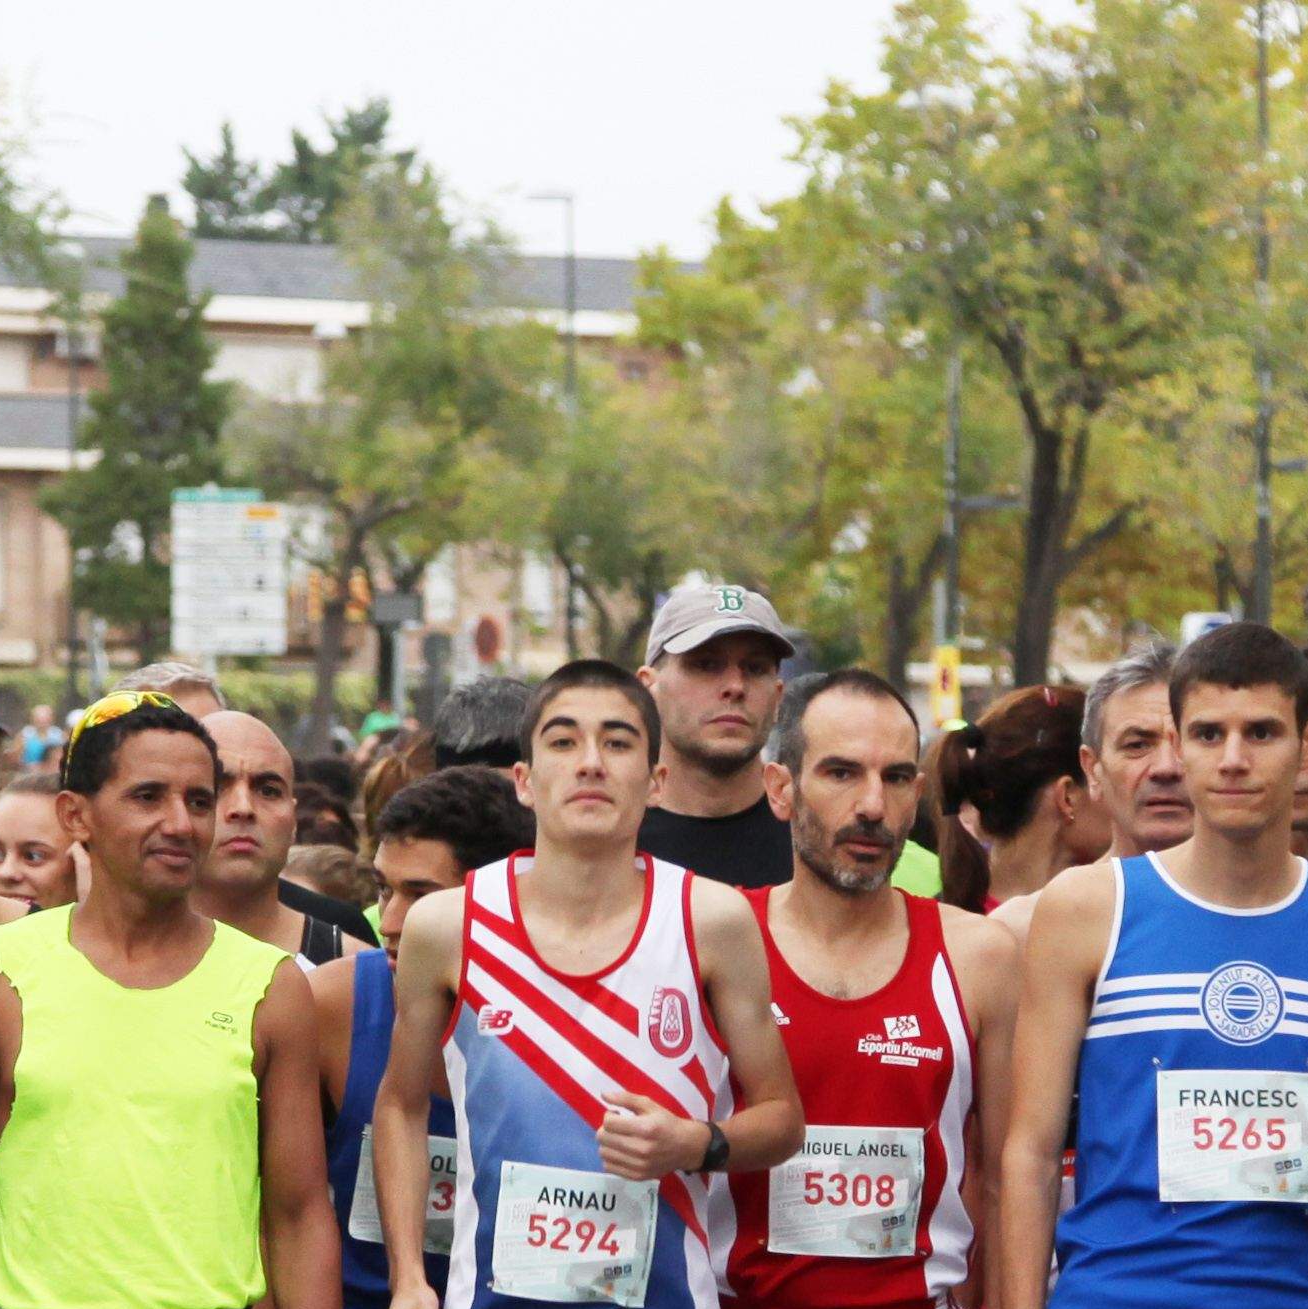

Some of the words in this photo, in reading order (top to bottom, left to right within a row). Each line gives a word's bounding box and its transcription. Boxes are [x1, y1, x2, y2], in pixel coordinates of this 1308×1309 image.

[858, 1039, 900, 1056] Esportiu
[1179, 1089, 1298, 1108] FRANCESC
[1193, 1117, 1286, 1150] 5265
[857, 1139, 907, 1157] ÁNGEL
[432, 1181, 454, 1211] 3
[537, 1186, 616, 1212] ARNAU
[804, 1170, 895, 1207] 5308
[527, 1213, 619, 1256] 5294
